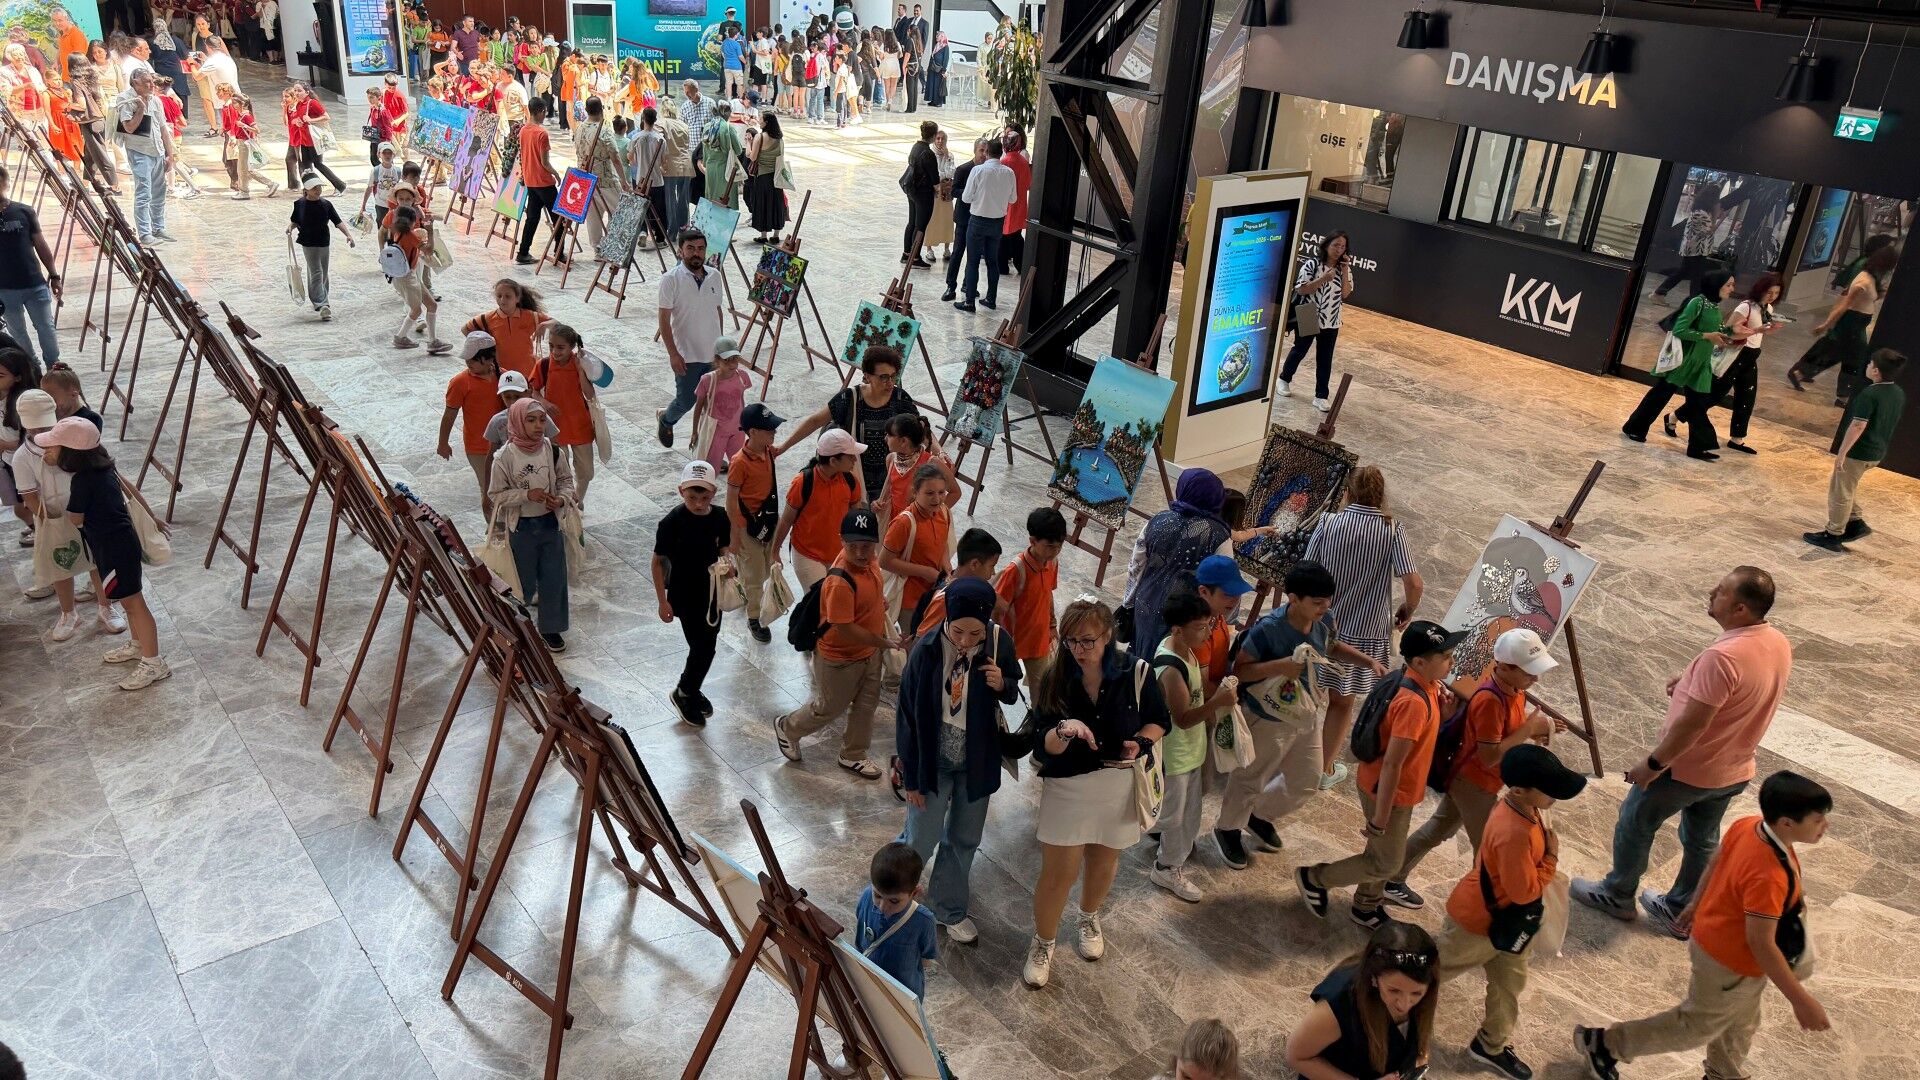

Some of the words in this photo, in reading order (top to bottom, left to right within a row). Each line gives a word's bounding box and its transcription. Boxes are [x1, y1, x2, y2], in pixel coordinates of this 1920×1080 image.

[619, 48, 645, 58] DÜNYA
[1446, 51, 1617, 109] DANIŞMA
[1320, 133, 1346, 148] GİŞE
[1212, 308, 1264, 332] EMANET
[855, 514, 868, 529] NY
